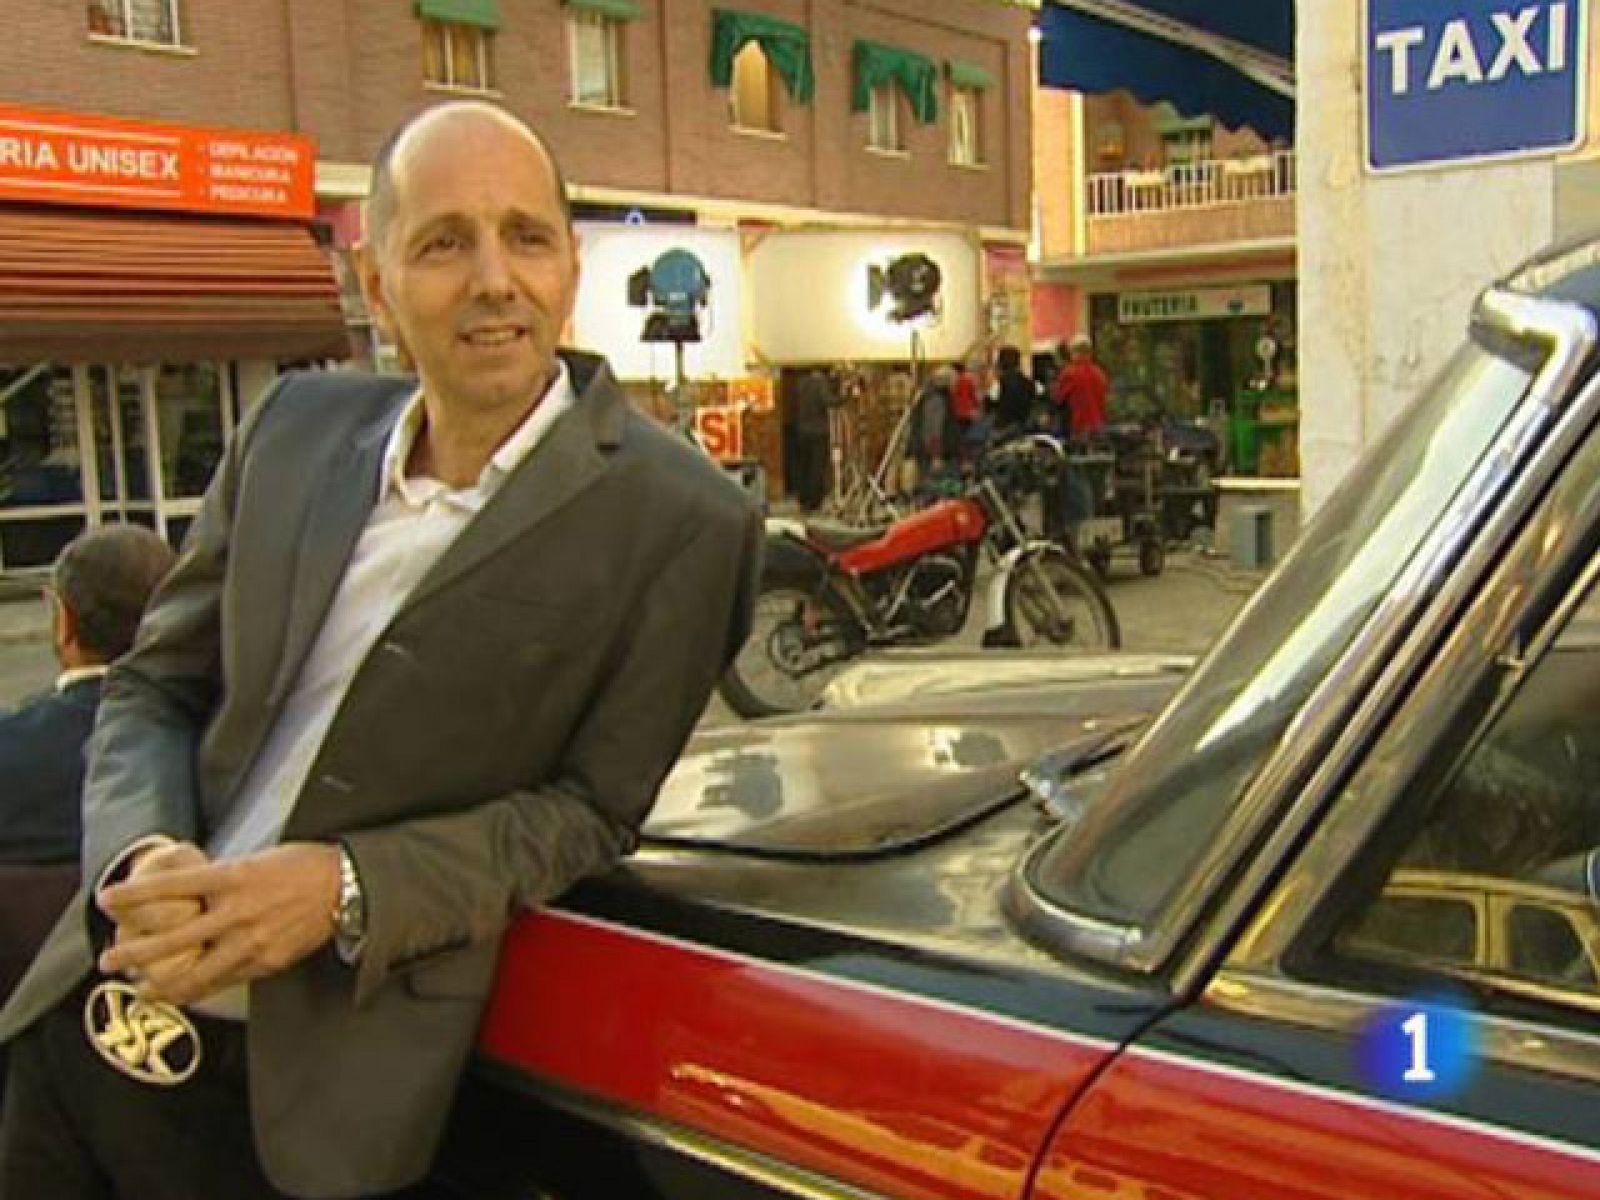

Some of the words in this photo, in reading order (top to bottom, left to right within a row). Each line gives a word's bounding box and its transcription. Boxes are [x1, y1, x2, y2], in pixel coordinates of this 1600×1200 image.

[1375, 3, 1567, 94] TAXI
[0, 137, 59, 171] RIA
[67, 140, 179, 181] UNISEX
